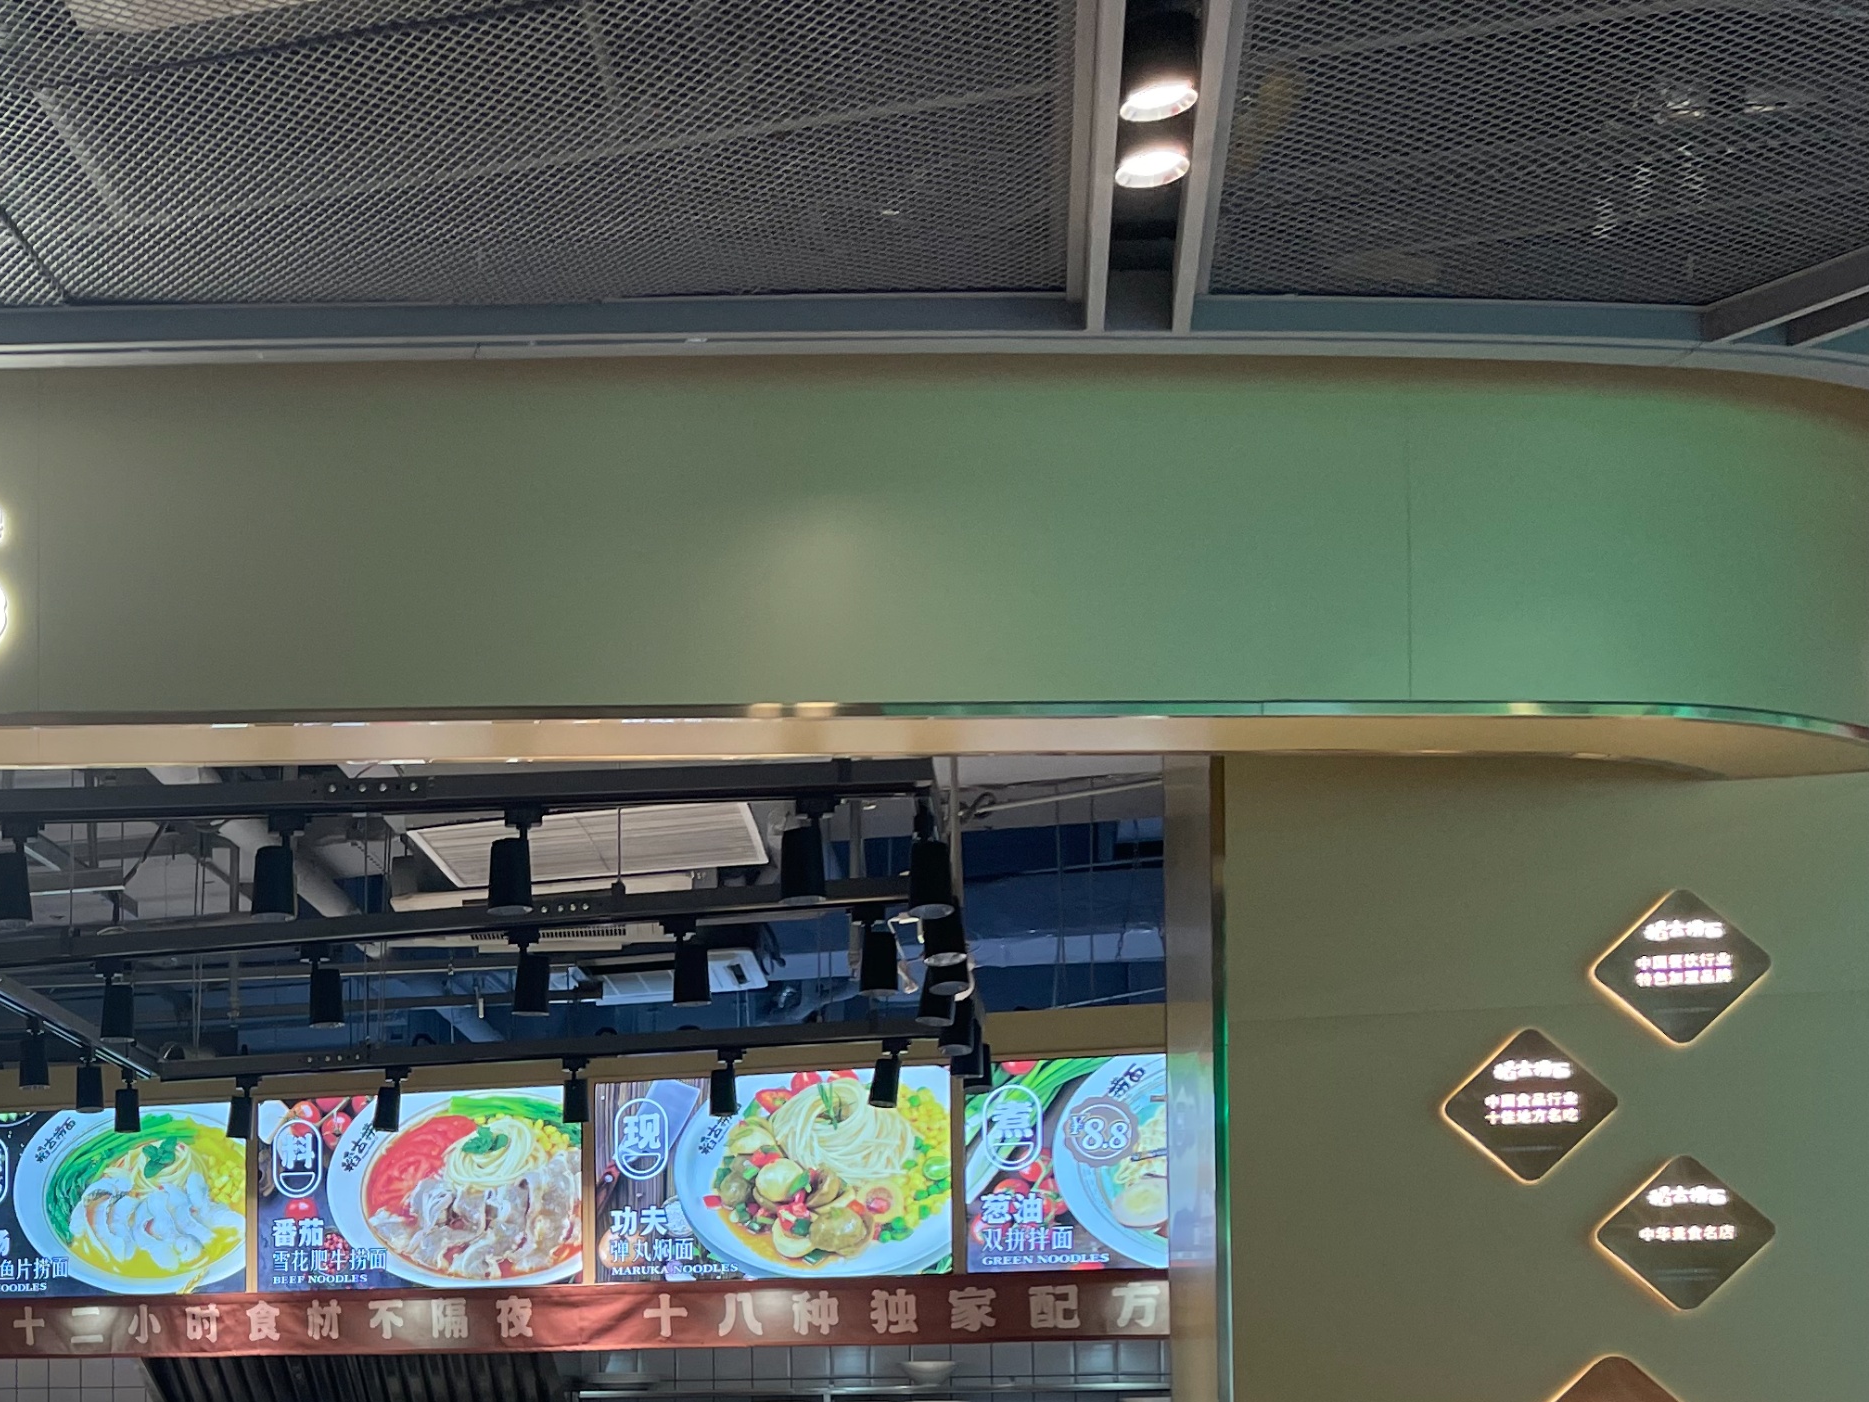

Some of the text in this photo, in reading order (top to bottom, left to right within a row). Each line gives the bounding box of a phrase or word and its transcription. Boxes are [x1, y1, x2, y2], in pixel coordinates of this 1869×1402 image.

[622, 1112, 662, 1150] 现
[991, 1100, 1035, 1140] 煮
[610, 1206, 668, 1236] 功夫
[980, 1193, 1045, 1224] 葱油
[272, 1218, 324, 1247] 番茄
[981, 1225, 1074, 1251] 双拼拌面
[272, 1248, 387, 1273] 雪花肥牛捞面
[610, 1237, 695, 1263] 弹丸焖面
[981, 1253, 1110, 1266] GREEN NOODLES
[272, 1273, 368, 1285] BEEF NOODLES
[611, 1262, 739, 1276] MARUKA NOODLES
[13, 1296, 535, 1346] 十二小时食材不隔夜
[643, 1283, 1163, 1338] 十八种独家配方
